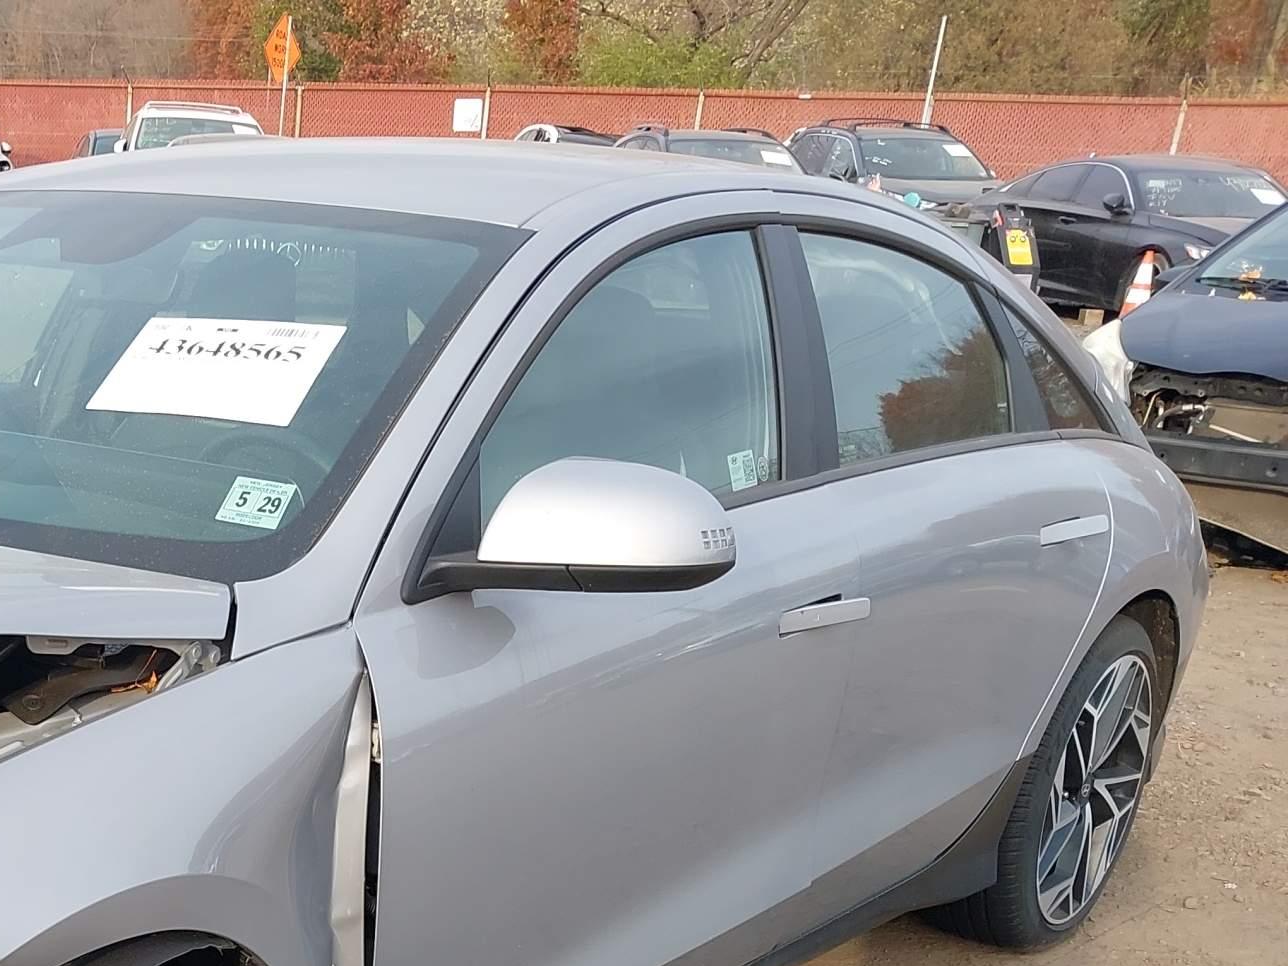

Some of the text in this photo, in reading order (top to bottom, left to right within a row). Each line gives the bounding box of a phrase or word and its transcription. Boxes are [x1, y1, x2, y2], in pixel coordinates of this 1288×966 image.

[148, 338, 306, 363] 43648565
[235, 491, 282, 514] 5 29
